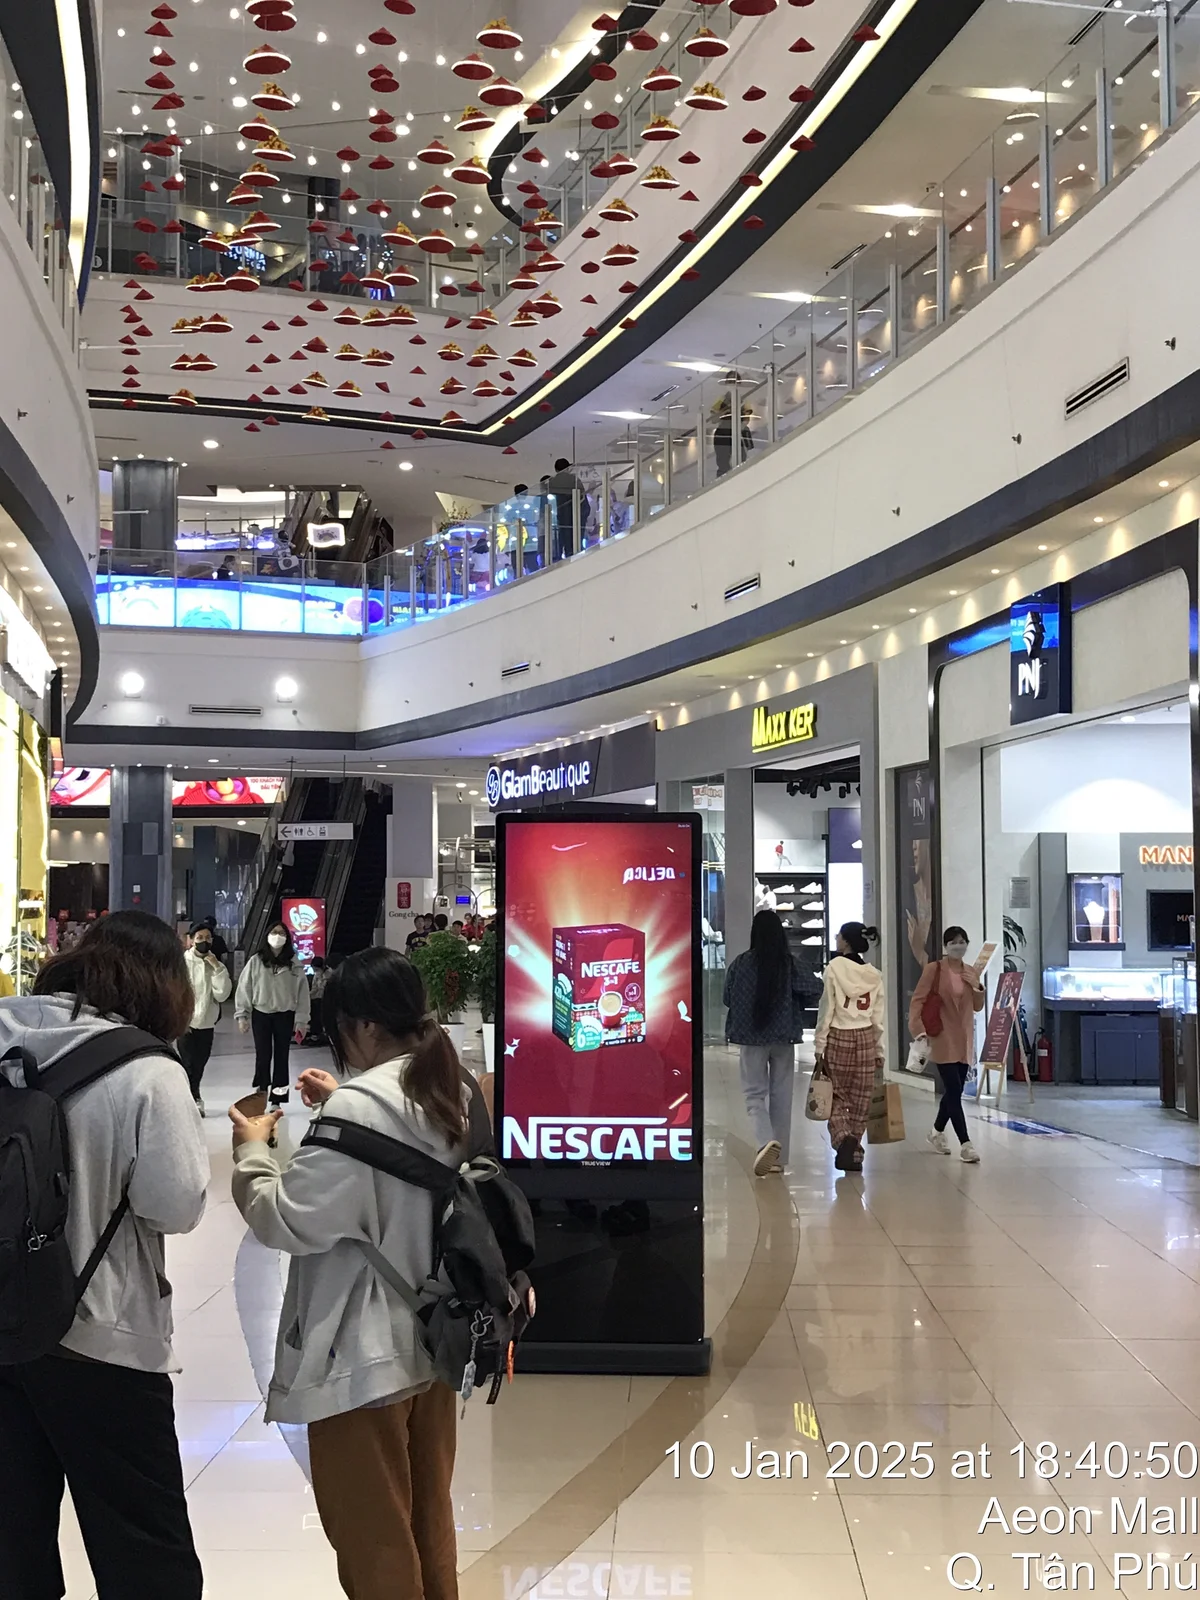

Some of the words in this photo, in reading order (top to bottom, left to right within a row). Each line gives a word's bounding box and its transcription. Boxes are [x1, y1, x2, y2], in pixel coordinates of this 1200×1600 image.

[1018, 658, 1040, 699] PNJ
[789, 702, 814, 738] KER
[502, 761, 590, 799] GlamBeautique
[913, 797, 925, 820] PNJ
[388, 911, 407, 919] Gong
